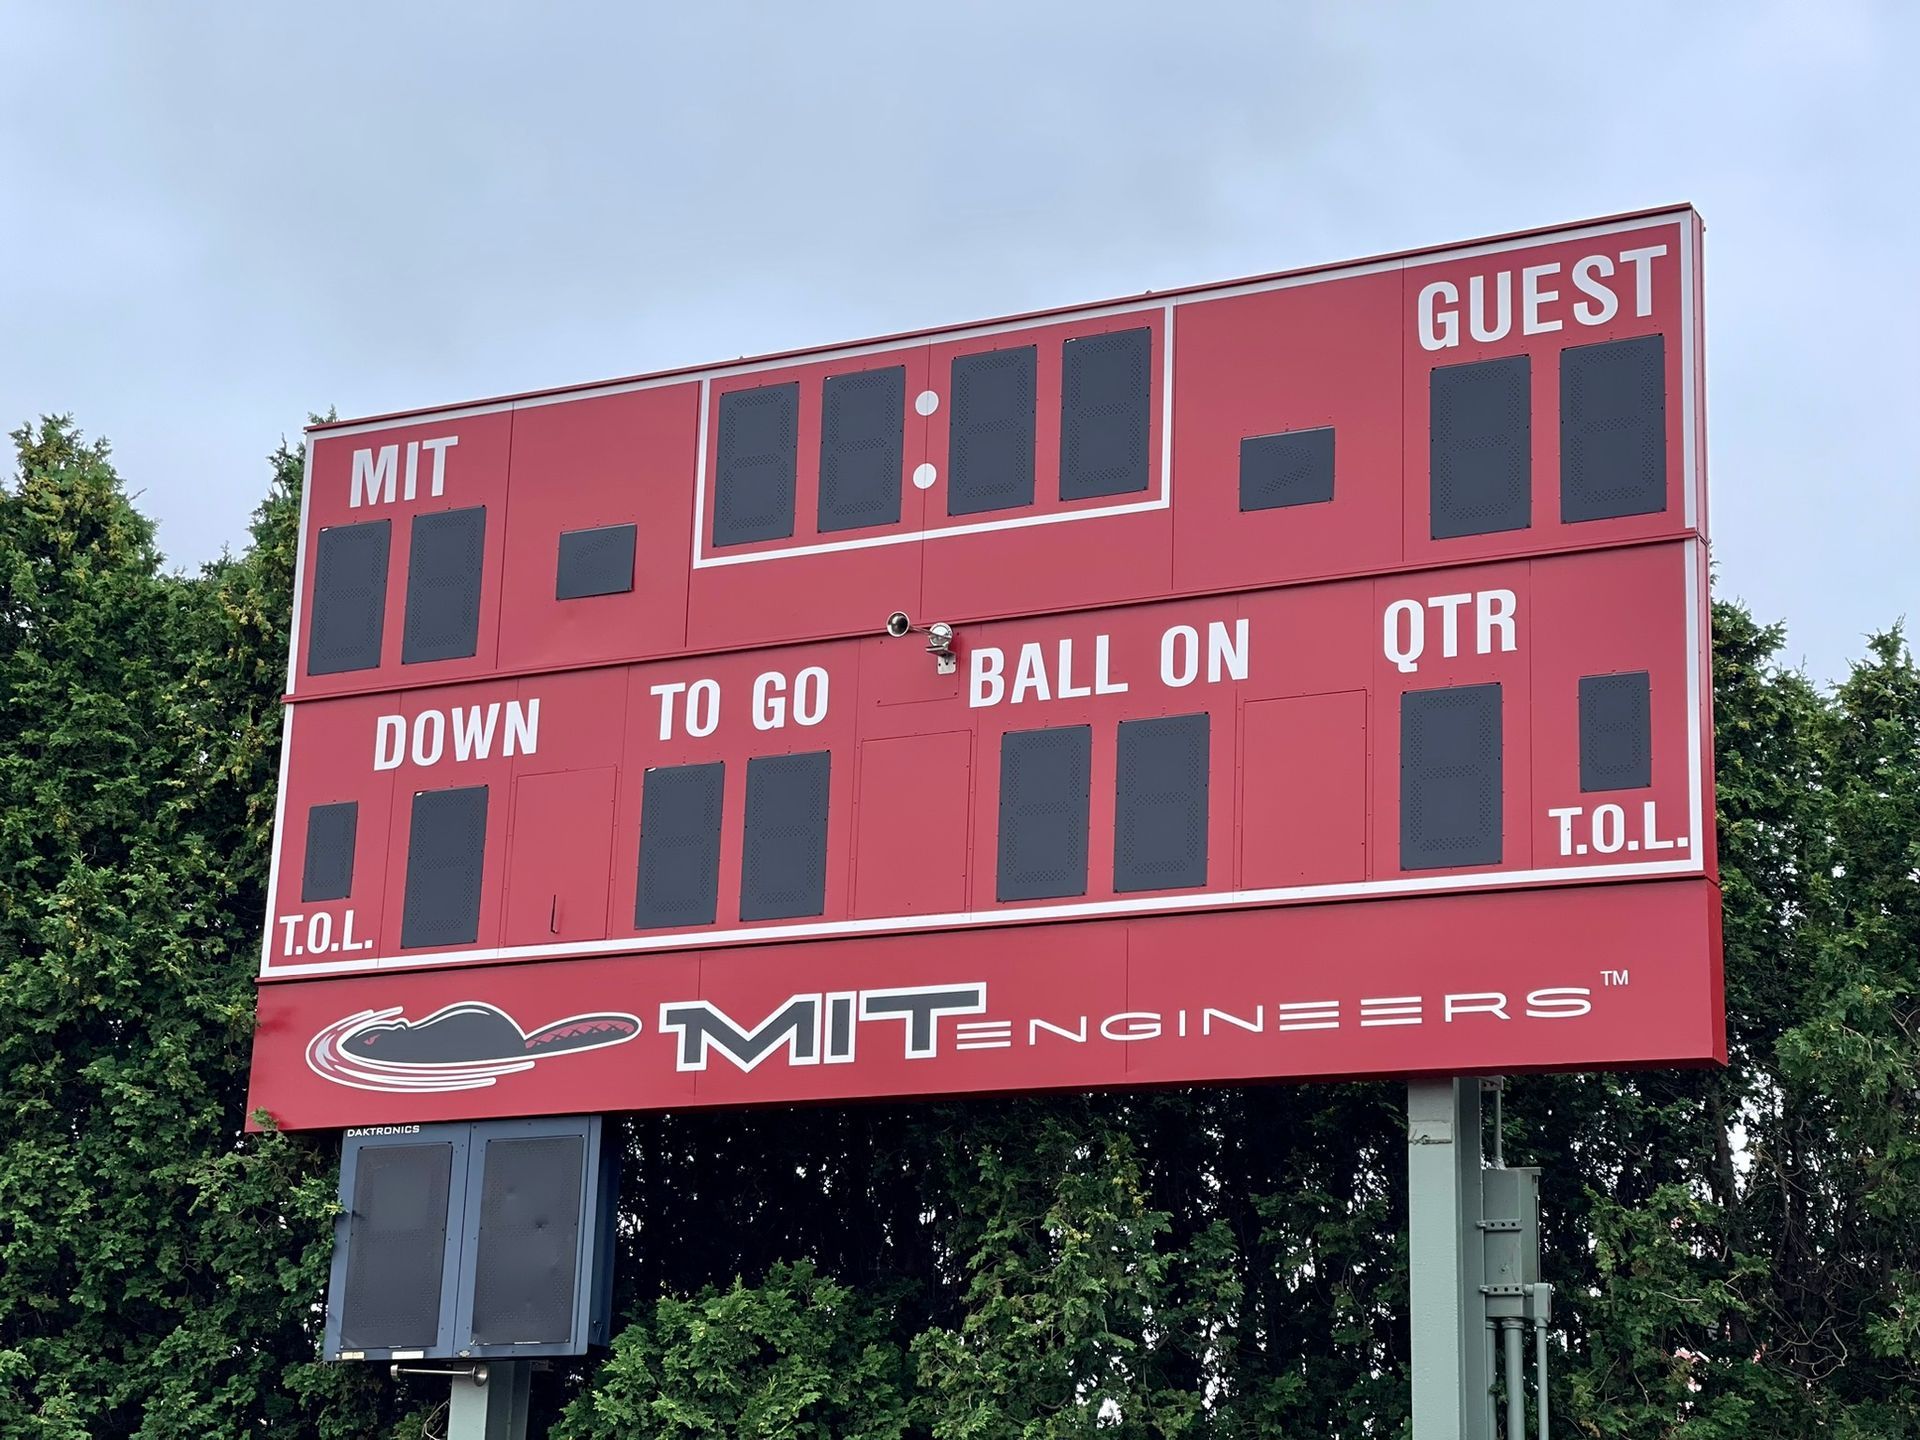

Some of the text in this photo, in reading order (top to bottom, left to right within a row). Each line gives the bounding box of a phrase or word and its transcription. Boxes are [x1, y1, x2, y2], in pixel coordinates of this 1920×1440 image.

[1417, 244, 1668, 351] GUEST
[349, 435, 459, 508] MIT
[969, 618, 1250, 709] BALL ON
[1383, 588, 1518, 674] QTR
[373, 698, 540, 771] DOWN
[650, 666, 829, 741] TO GO
[1548, 800, 1689, 856] T.O.L.
[279, 909, 373, 957] T.O.L.
[658, 981, 987, 1074] MIT
[956, 987, 1592, 1050] ENGINEERS
[347, 1125, 420, 1138] DAKTRONICS
